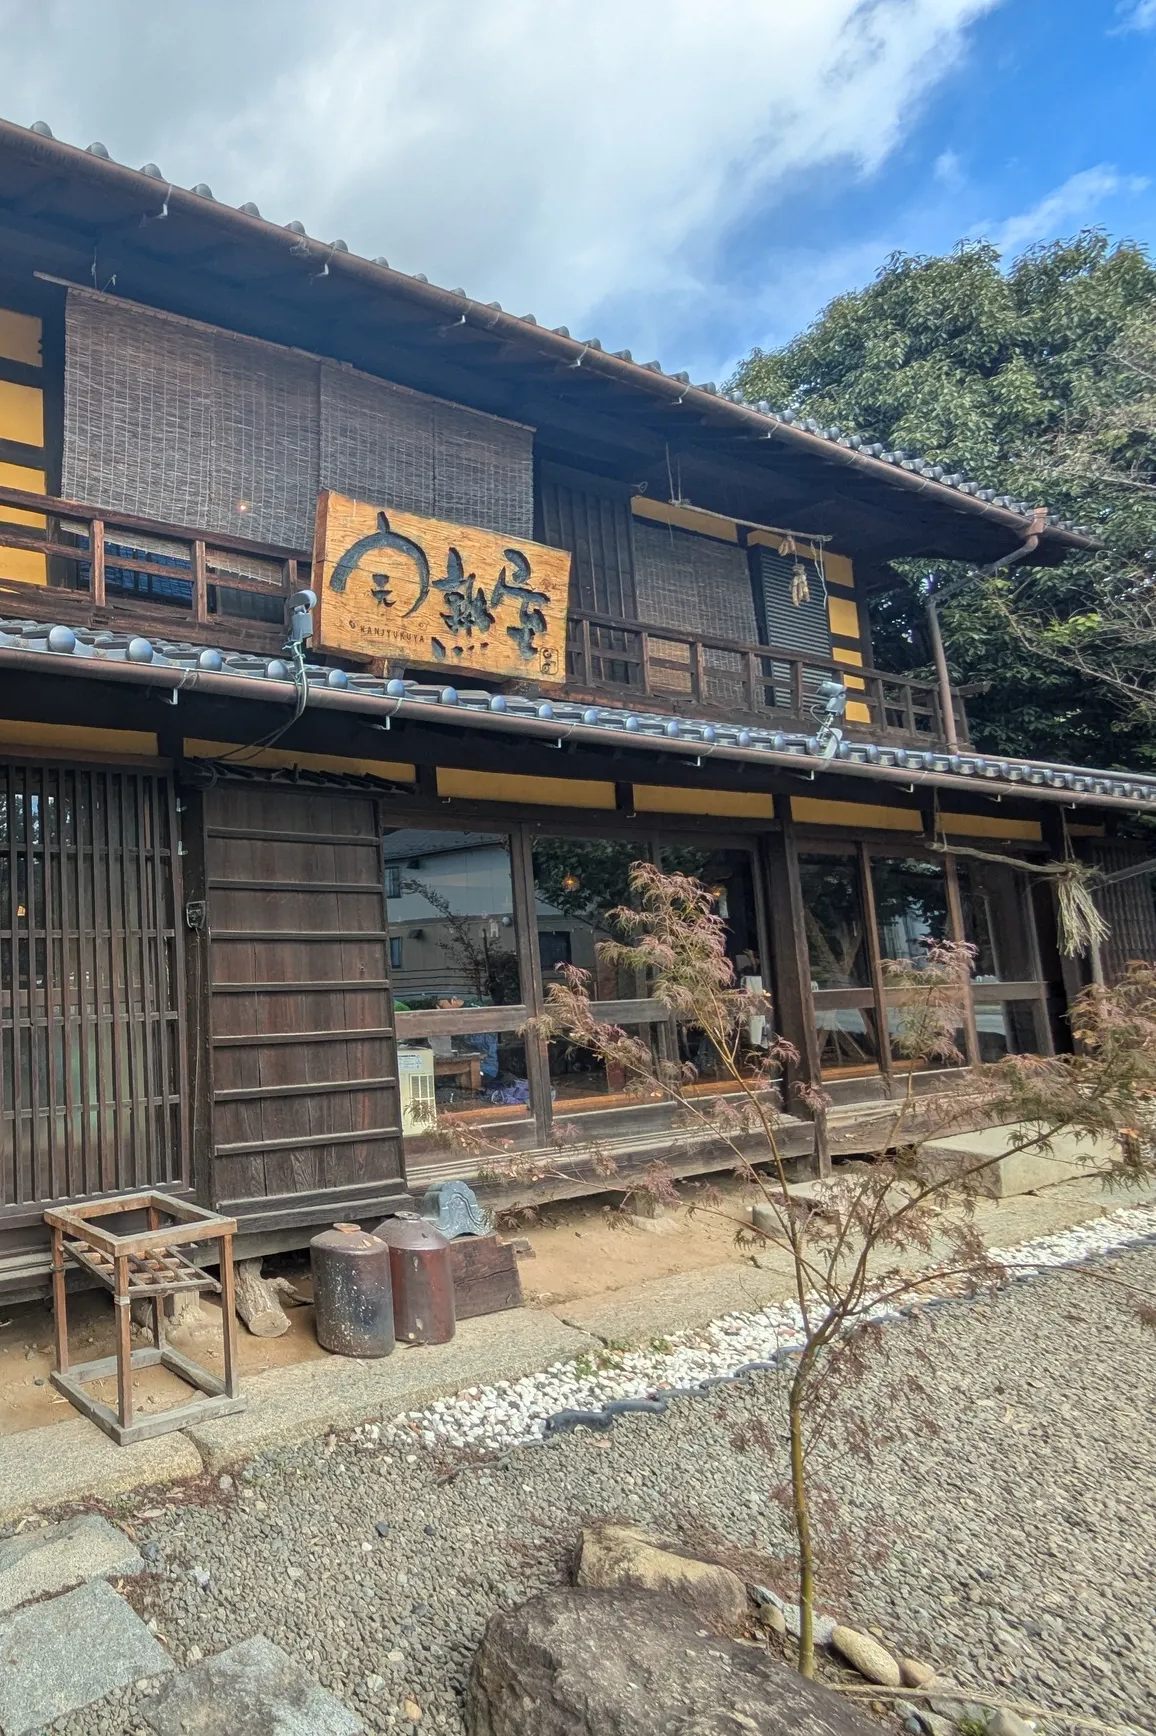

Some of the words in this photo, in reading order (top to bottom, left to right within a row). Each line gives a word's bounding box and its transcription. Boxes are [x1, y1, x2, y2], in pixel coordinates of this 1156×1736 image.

[329, 511, 550, 660] 完熟屋
[360, 625, 425, 643] KANJYUKUYA
